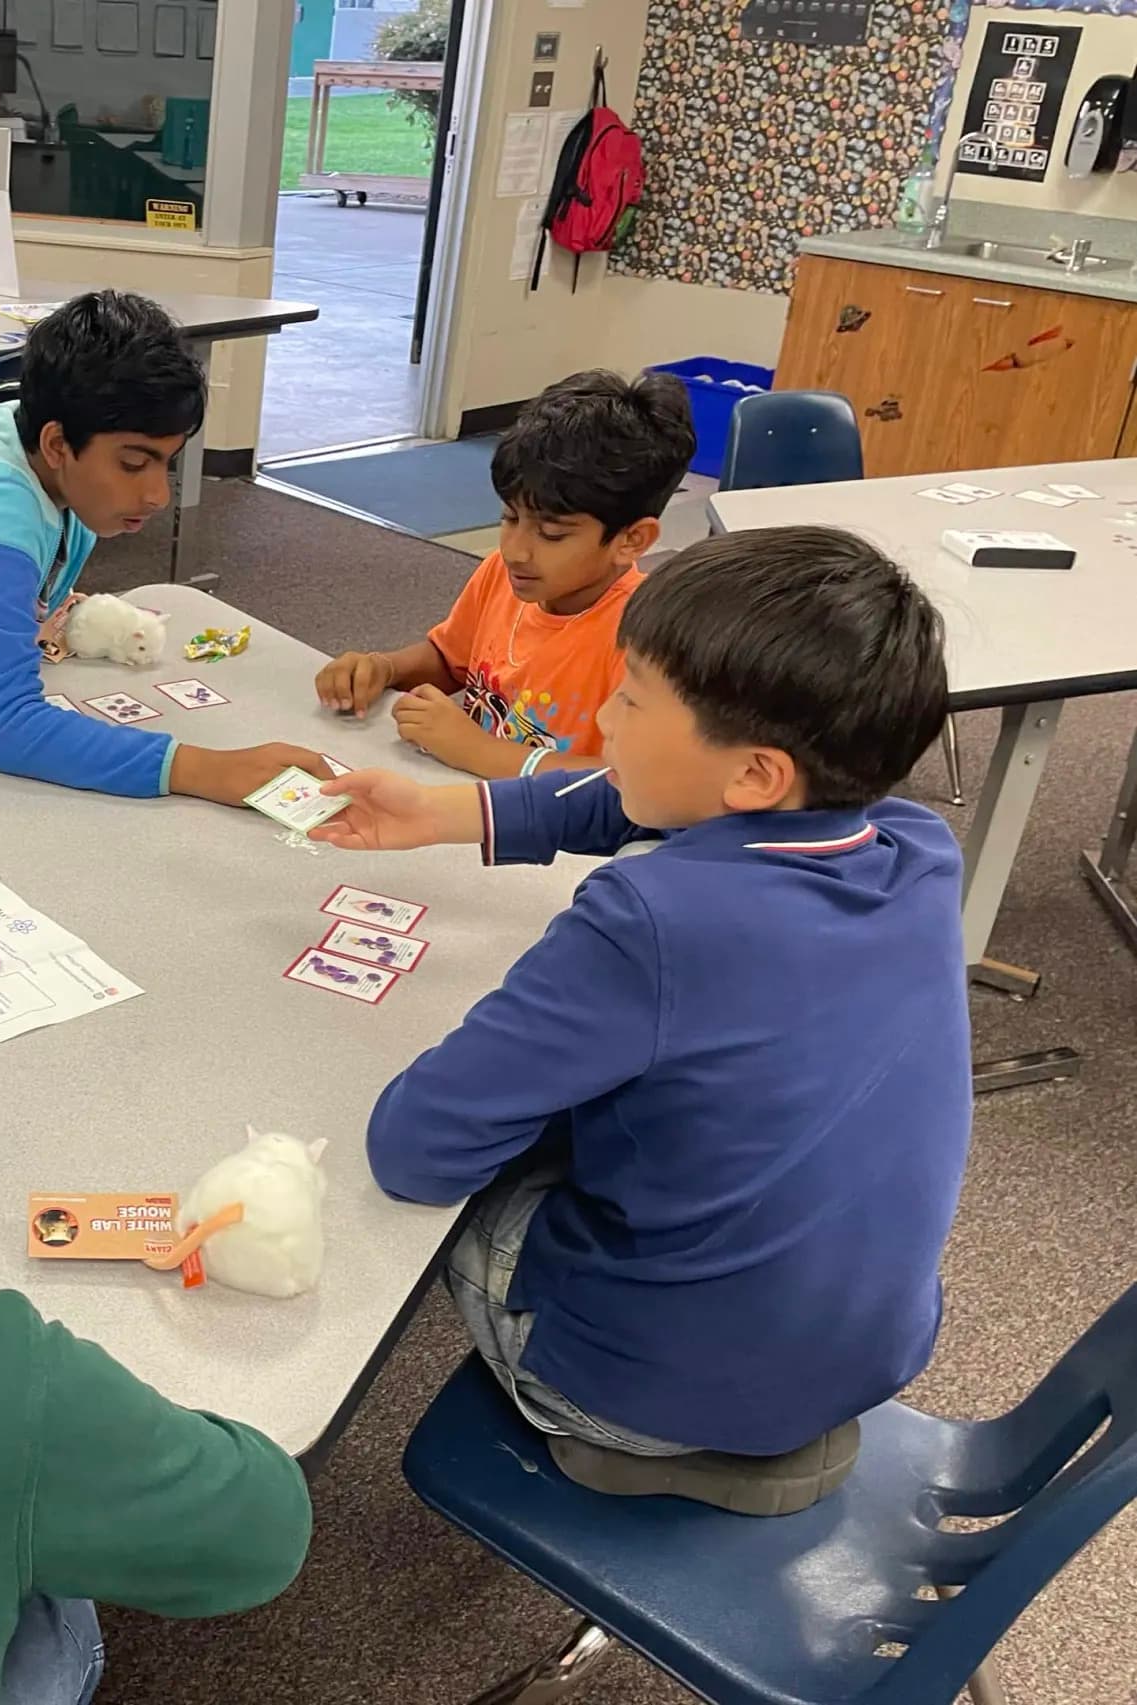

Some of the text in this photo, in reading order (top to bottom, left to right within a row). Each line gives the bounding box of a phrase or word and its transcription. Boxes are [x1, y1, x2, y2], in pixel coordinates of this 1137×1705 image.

[119, 1206, 171, 1218] MOUSE
[91, 1220, 172, 1232] WHITE LAB
